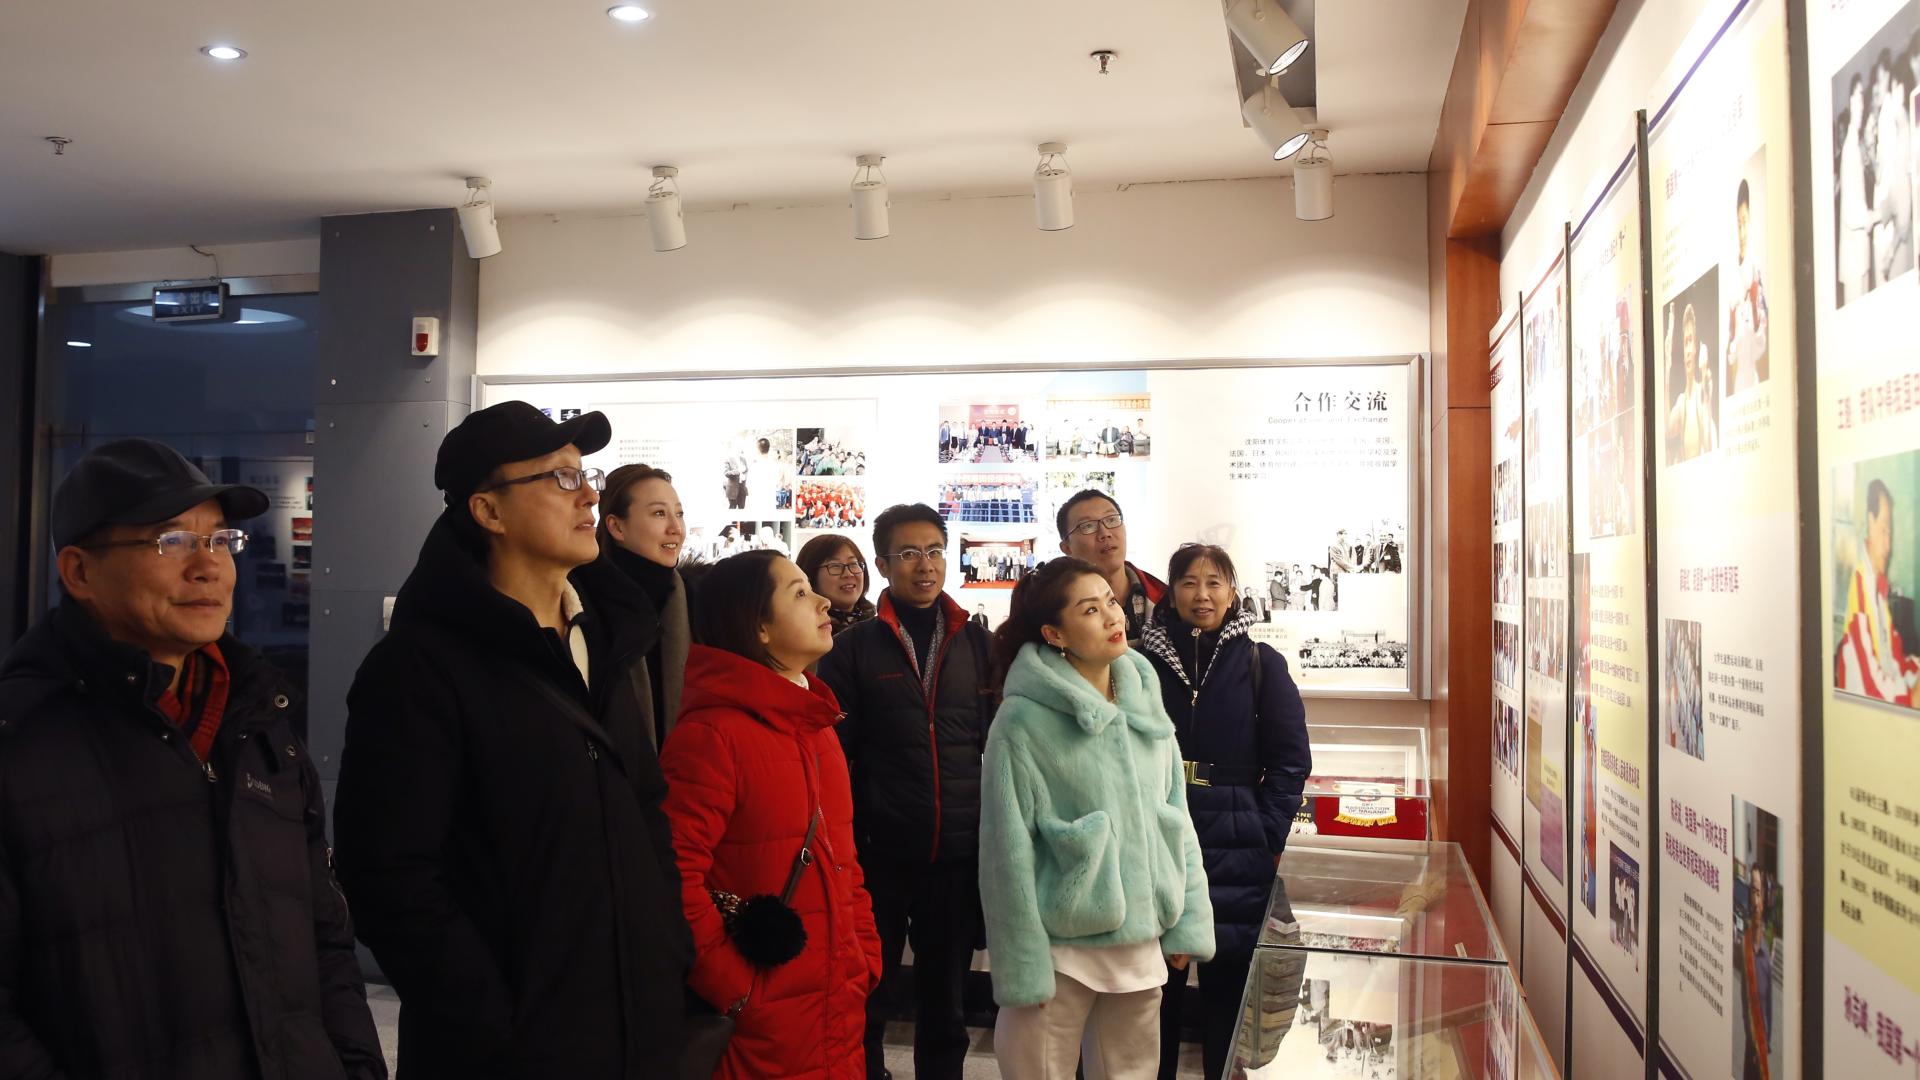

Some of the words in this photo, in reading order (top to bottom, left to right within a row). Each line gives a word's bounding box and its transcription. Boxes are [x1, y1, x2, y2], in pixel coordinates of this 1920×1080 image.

[1294, 390, 1388, 412] 合作交流
[1268, 416, 1323, 424] Cooperat
